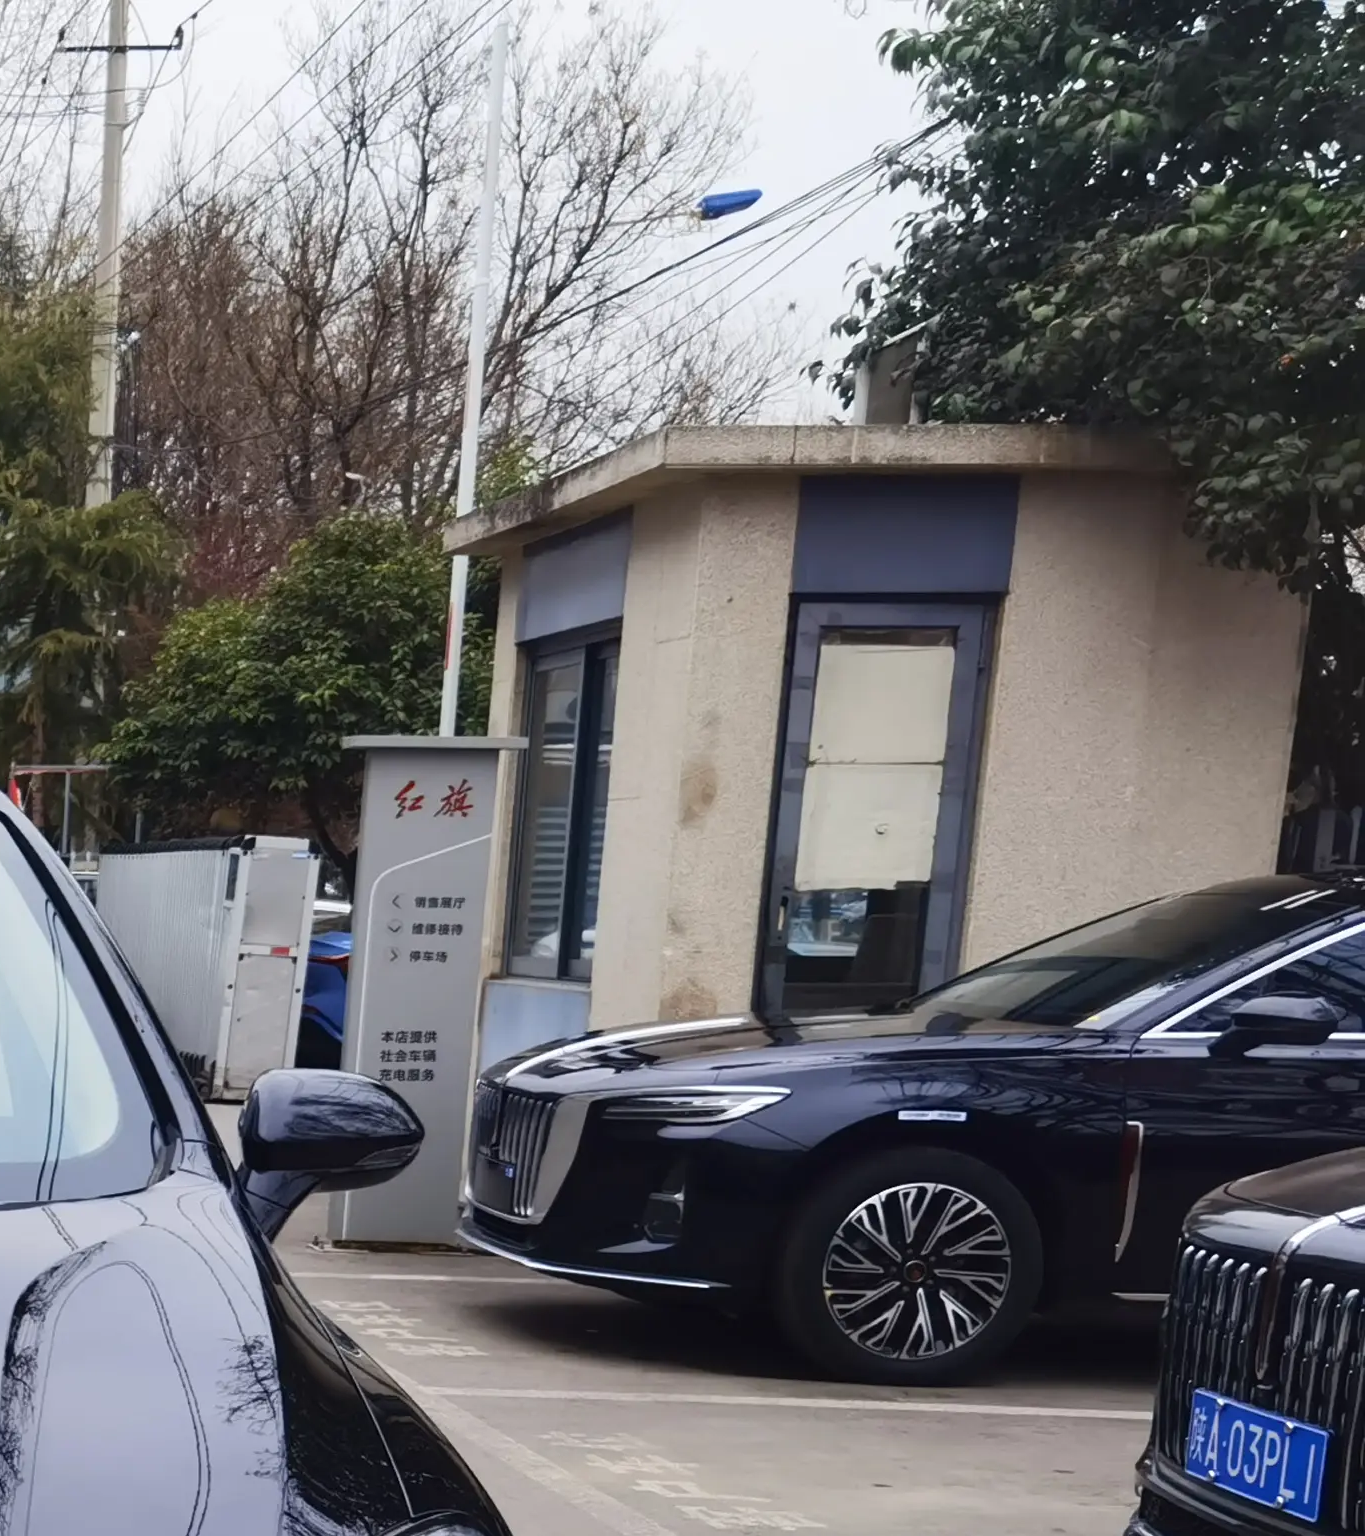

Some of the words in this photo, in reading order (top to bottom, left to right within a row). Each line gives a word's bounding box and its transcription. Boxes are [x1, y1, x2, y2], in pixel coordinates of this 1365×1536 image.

[394, 779, 474, 819] 红旗
[414, 896, 466, 910] 销售展厅
[411, 922, 463, 937] 维修接待
[409, 950, 448, 963] 停车场
[380, 1030, 438, 1044] 本店提供
[379, 1049, 437, 1063] 社会车辆
[379, 1068, 436, 1082] 充电服务
